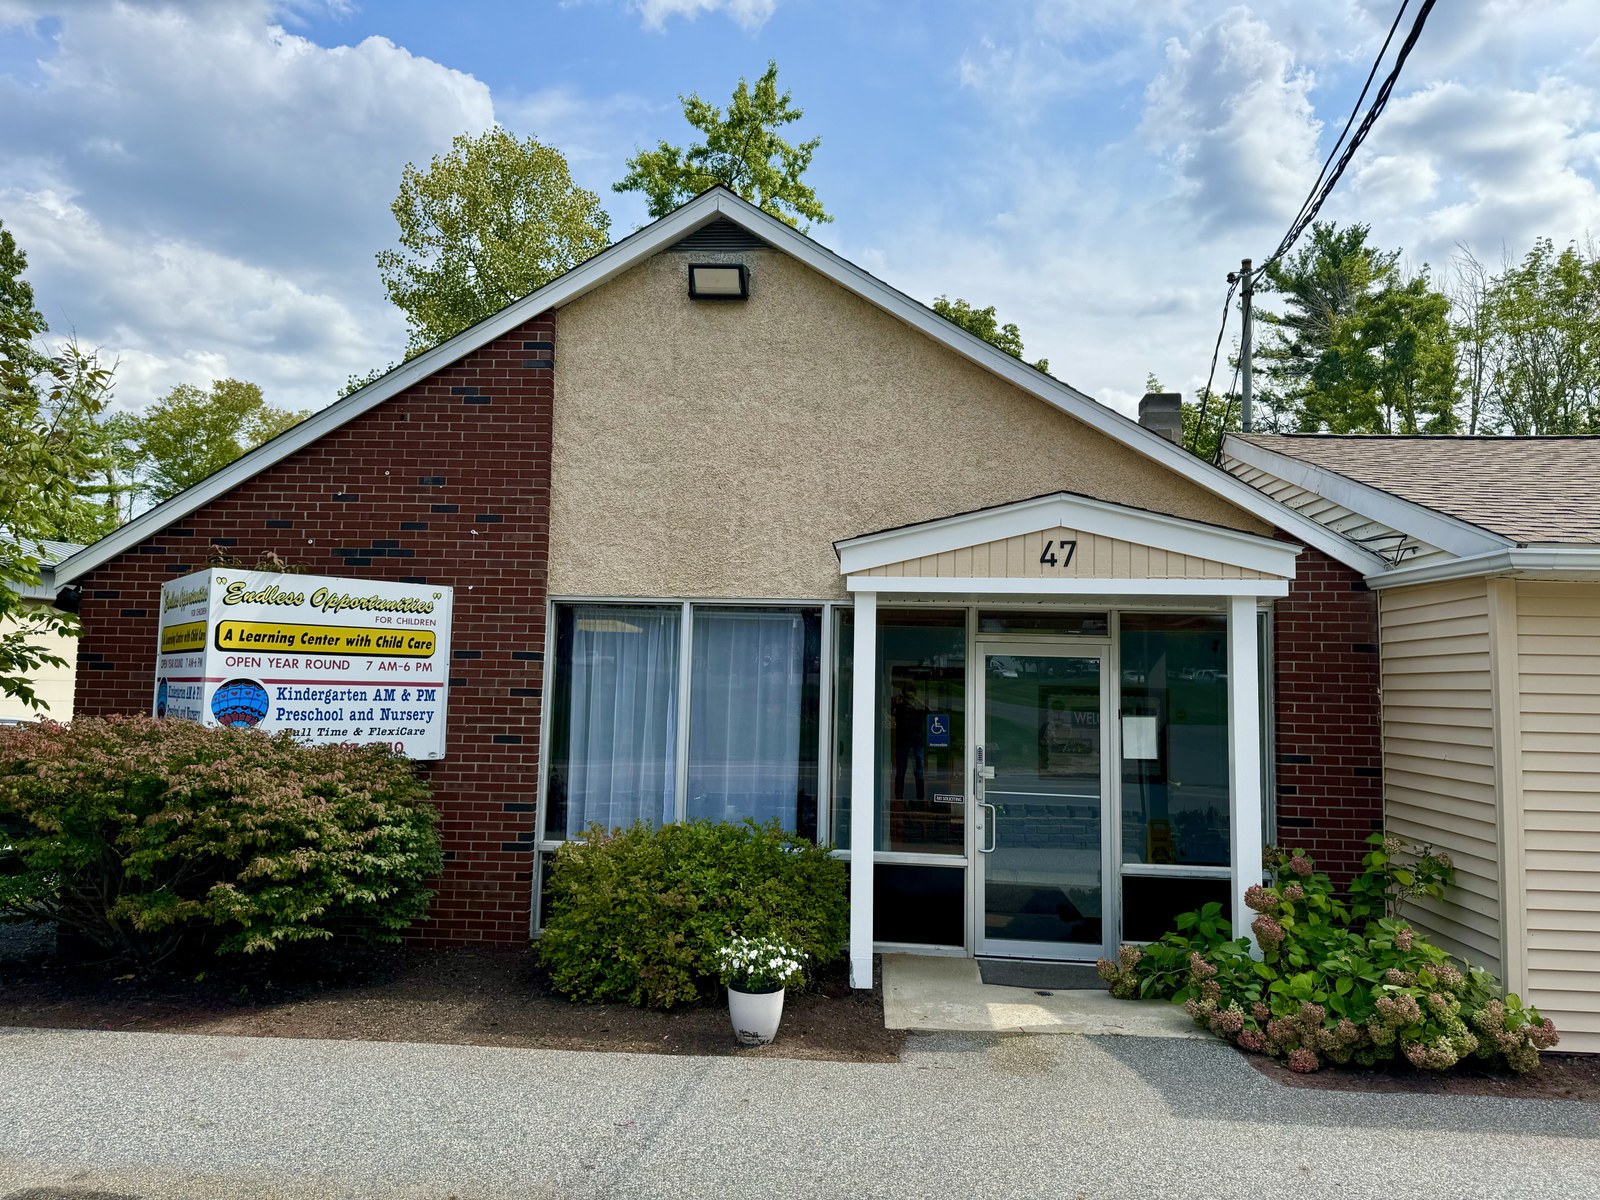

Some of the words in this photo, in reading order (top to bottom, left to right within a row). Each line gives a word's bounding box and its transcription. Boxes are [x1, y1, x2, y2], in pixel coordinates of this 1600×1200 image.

[1040, 541, 1076, 567] 47
[375, 616, 392, 624] FOR
[396, 617, 437, 626] CHILDREN
[223, 629, 233, 641] A
[239, 630, 295, 647] Learning
[301, 632, 341, 646] Center
[346, 633, 372, 648] with
[376, 635, 404, 649] Child
[408, 637, 432, 650] Care
[225, 656, 261, 668] OPEN
[267, 657, 299, 669] YEAR
[305, 658, 350, 670] ROUND
[366, 661, 373, 671] 7
[378, 661, 411, 672] AM-6
[416, 662, 433, 672] PM
[276, 687, 368, 704] Kindergarten
[373, 689, 396, 701] AM
[401, 689, 411, 702] &
[416, 689, 436, 702] PM
[275, 707, 344, 721] Preschool
[350, 708, 374, 721] and
[380, 708, 435, 724] Nursery
[317, 727, 348, 736] Time
[353, 727, 364, 736] &
[368, 727, 426, 736] FlexiCare
